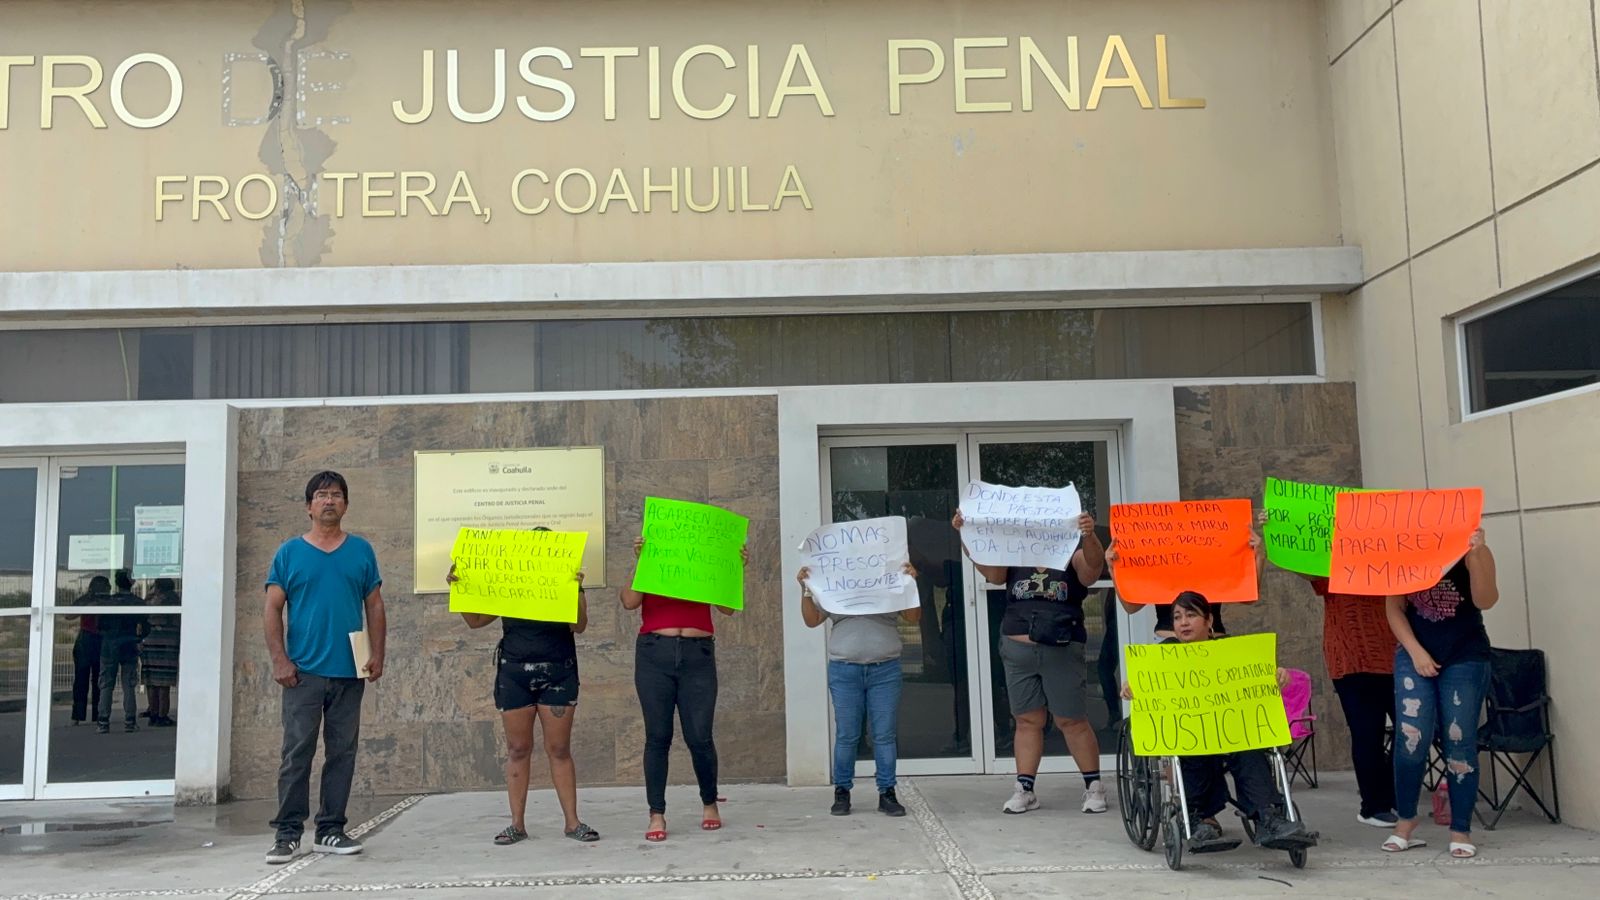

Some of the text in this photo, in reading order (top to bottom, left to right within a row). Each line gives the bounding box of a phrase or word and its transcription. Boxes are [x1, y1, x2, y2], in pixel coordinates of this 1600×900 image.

[392, 43, 836, 125] JUSTICIA
[887, 33, 1207, 116] PENAL
[510, 165, 814, 216] COAHUILA
[968, 483, 1062, 504] DONDE ESTA
[1273, 479, 1353, 503] QUEREM
[647, 502, 712, 526] AGARREN
[976, 502, 998, 515] EL
[1112, 501, 1223, 519] JUSTICIA PARA
[1267, 507, 1291, 523] POR
[1337, 490, 1467, 531] JUSTICIA
[976, 526, 995, 537] EN
[1002, 527, 1021, 537] LA
[985, 516, 1020, 527] DEBE
[1024, 517, 1065, 530] ESTAR
[1190, 519, 1230, 532] MARIO
[1295, 523, 1331, 540] Y POR
[805, 526, 890, 553] NO MAS
[971, 539, 1072, 556] DA LA CARA
[1117, 534, 1223, 551] NO MAS PRESOS
[1270, 533, 1316, 552] MARIO
[1340, 532, 1445, 557] PARA REY
[454, 556, 491, 571] ESTAR
[495, 559, 514, 571] EN
[519, 560, 536, 572] LA
[817, 553, 889, 575] PRESOS
[1119, 551, 1193, 569] INOCENTES
[484, 571, 535, 585] QUEREMOS
[537, 575, 559, 587] QUE
[821, 572, 899, 593] INOCENTES
[1344, 560, 1443, 588] Y MARIO
[454, 582, 474, 596] DE
[478, 584, 497, 598] LA
[498, 586, 537, 600] CARA
[1128, 644, 1210, 661] NO MAS
[1137, 669, 1212, 693] CHIVOS
[1133, 698, 1167, 713] ELLOS
[1170, 695, 1200, 711] SOLO
[1204, 691, 1231, 706] SON
[1142, 703, 1278, 752] JUSTICIA
